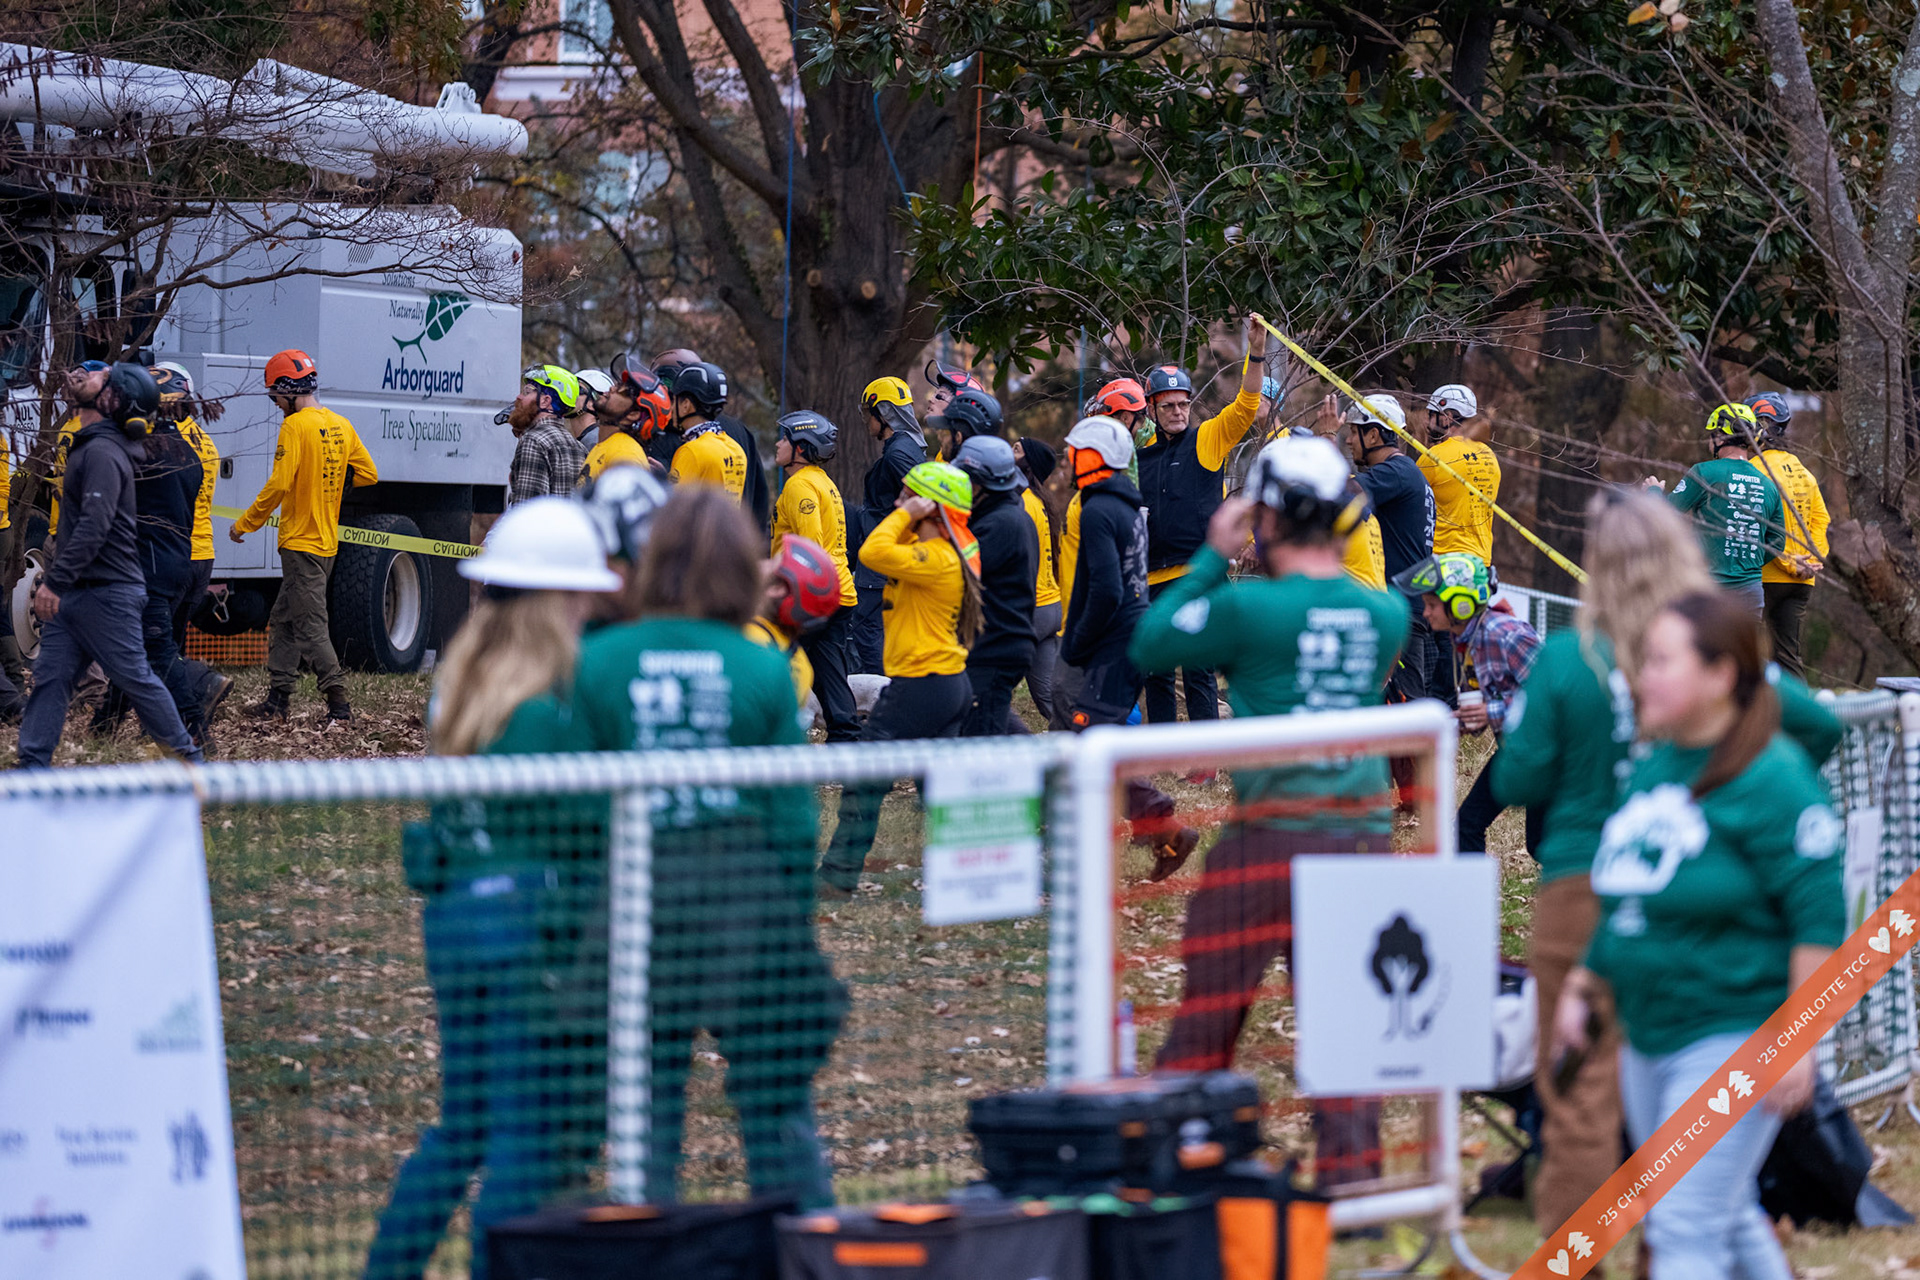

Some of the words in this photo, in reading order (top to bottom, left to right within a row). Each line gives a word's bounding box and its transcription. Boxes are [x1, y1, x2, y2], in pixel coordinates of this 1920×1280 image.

[389, 300, 425, 326] Naturally
[382, 356, 464, 400] Arborguard
[381, 409, 404, 440] Tree
[407, 409, 462, 451] Specialists
